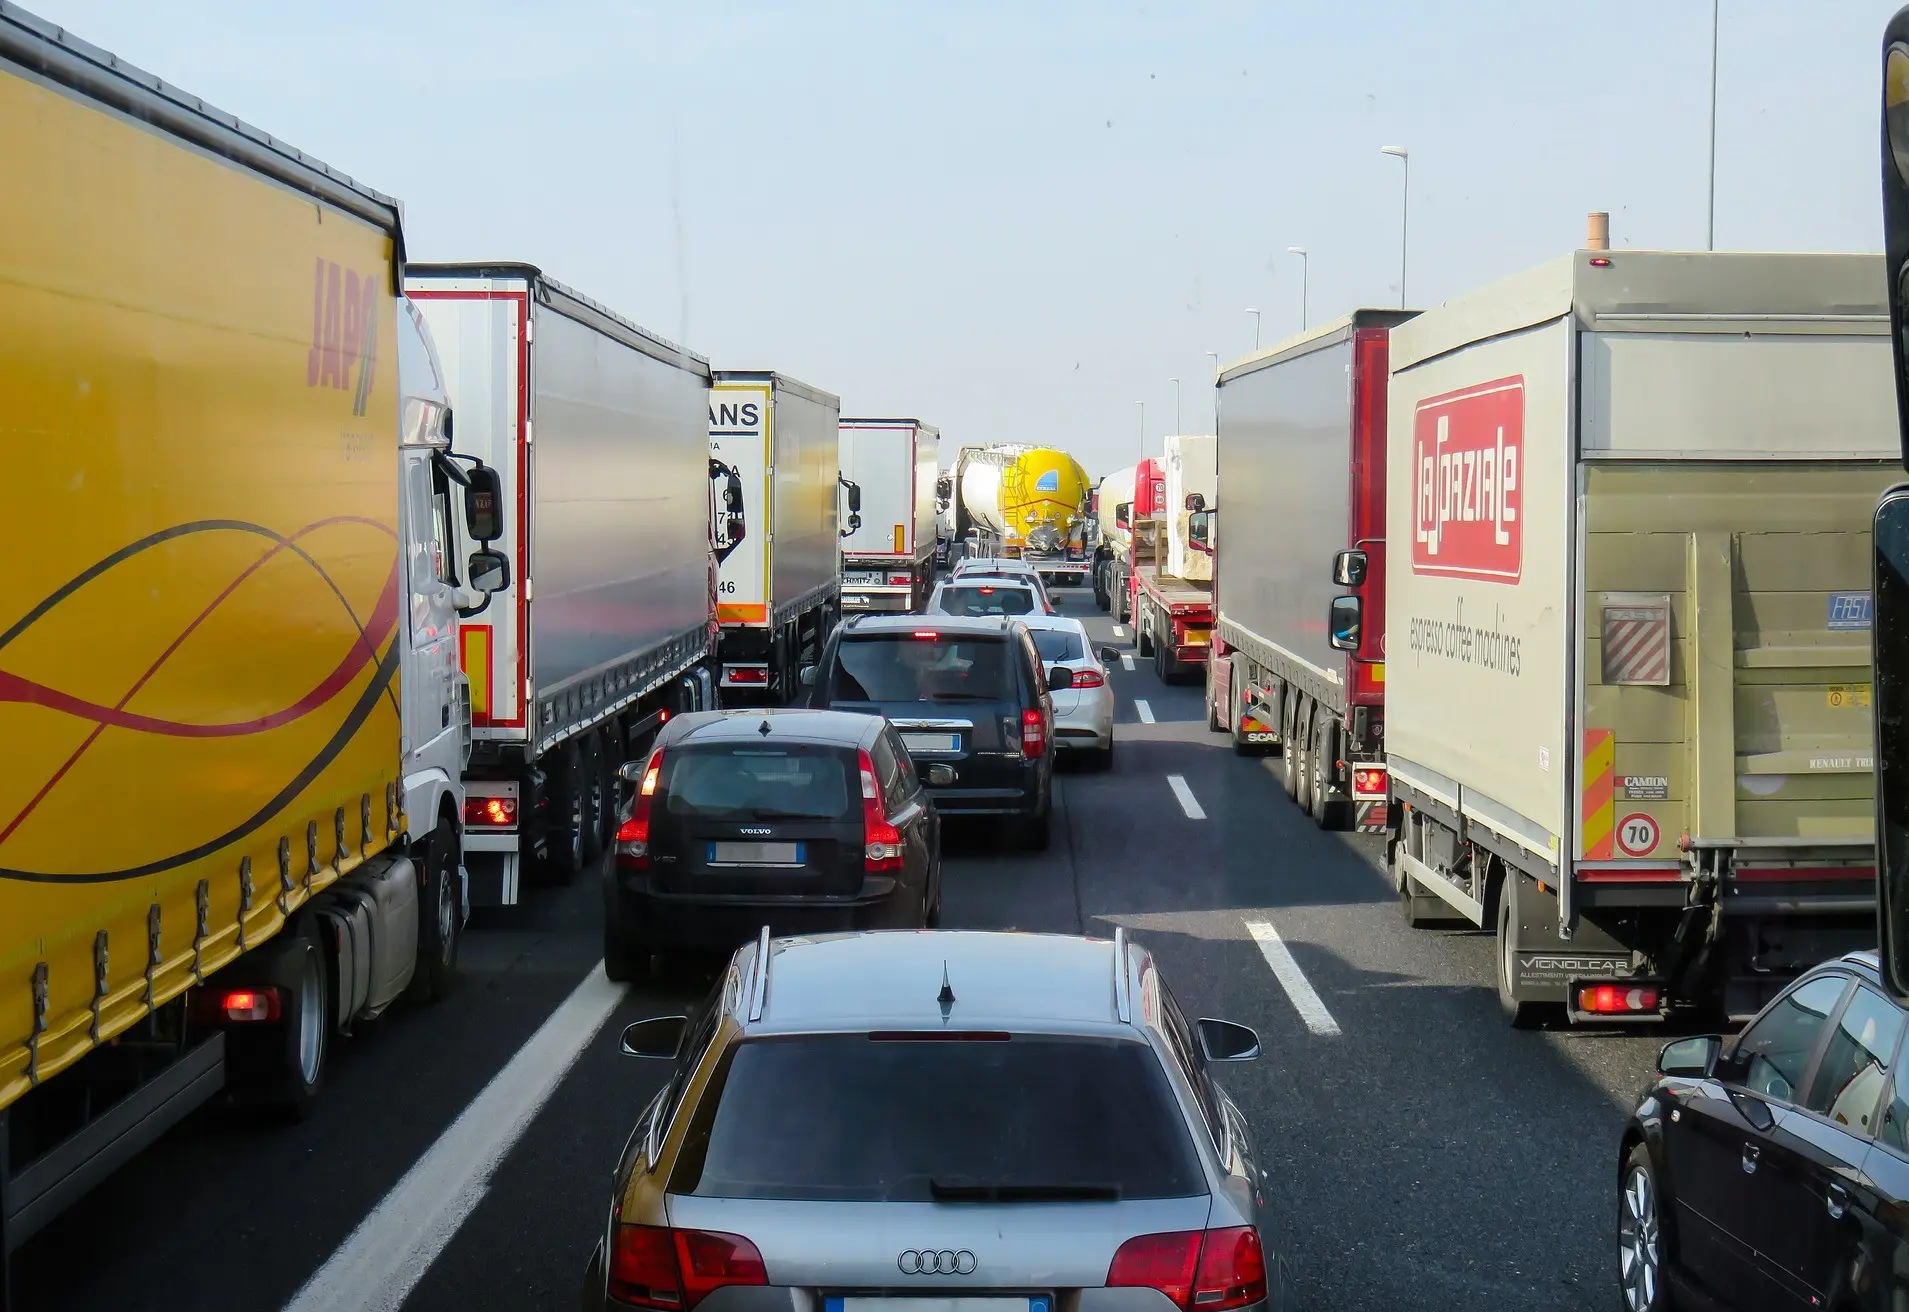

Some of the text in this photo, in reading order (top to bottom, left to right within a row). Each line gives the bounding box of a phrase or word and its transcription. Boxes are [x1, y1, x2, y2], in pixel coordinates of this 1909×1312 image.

[718, 581, 735, 593] 46
[1410, 596, 1521, 677] espresso coffee machines
[1247, 733, 1278, 742] SCA
[1809, 758, 1851, 769] RENAULT
[1628, 825, 1649, 844] 70
[1520, 956, 1628, 970] VIGNOLCAR
